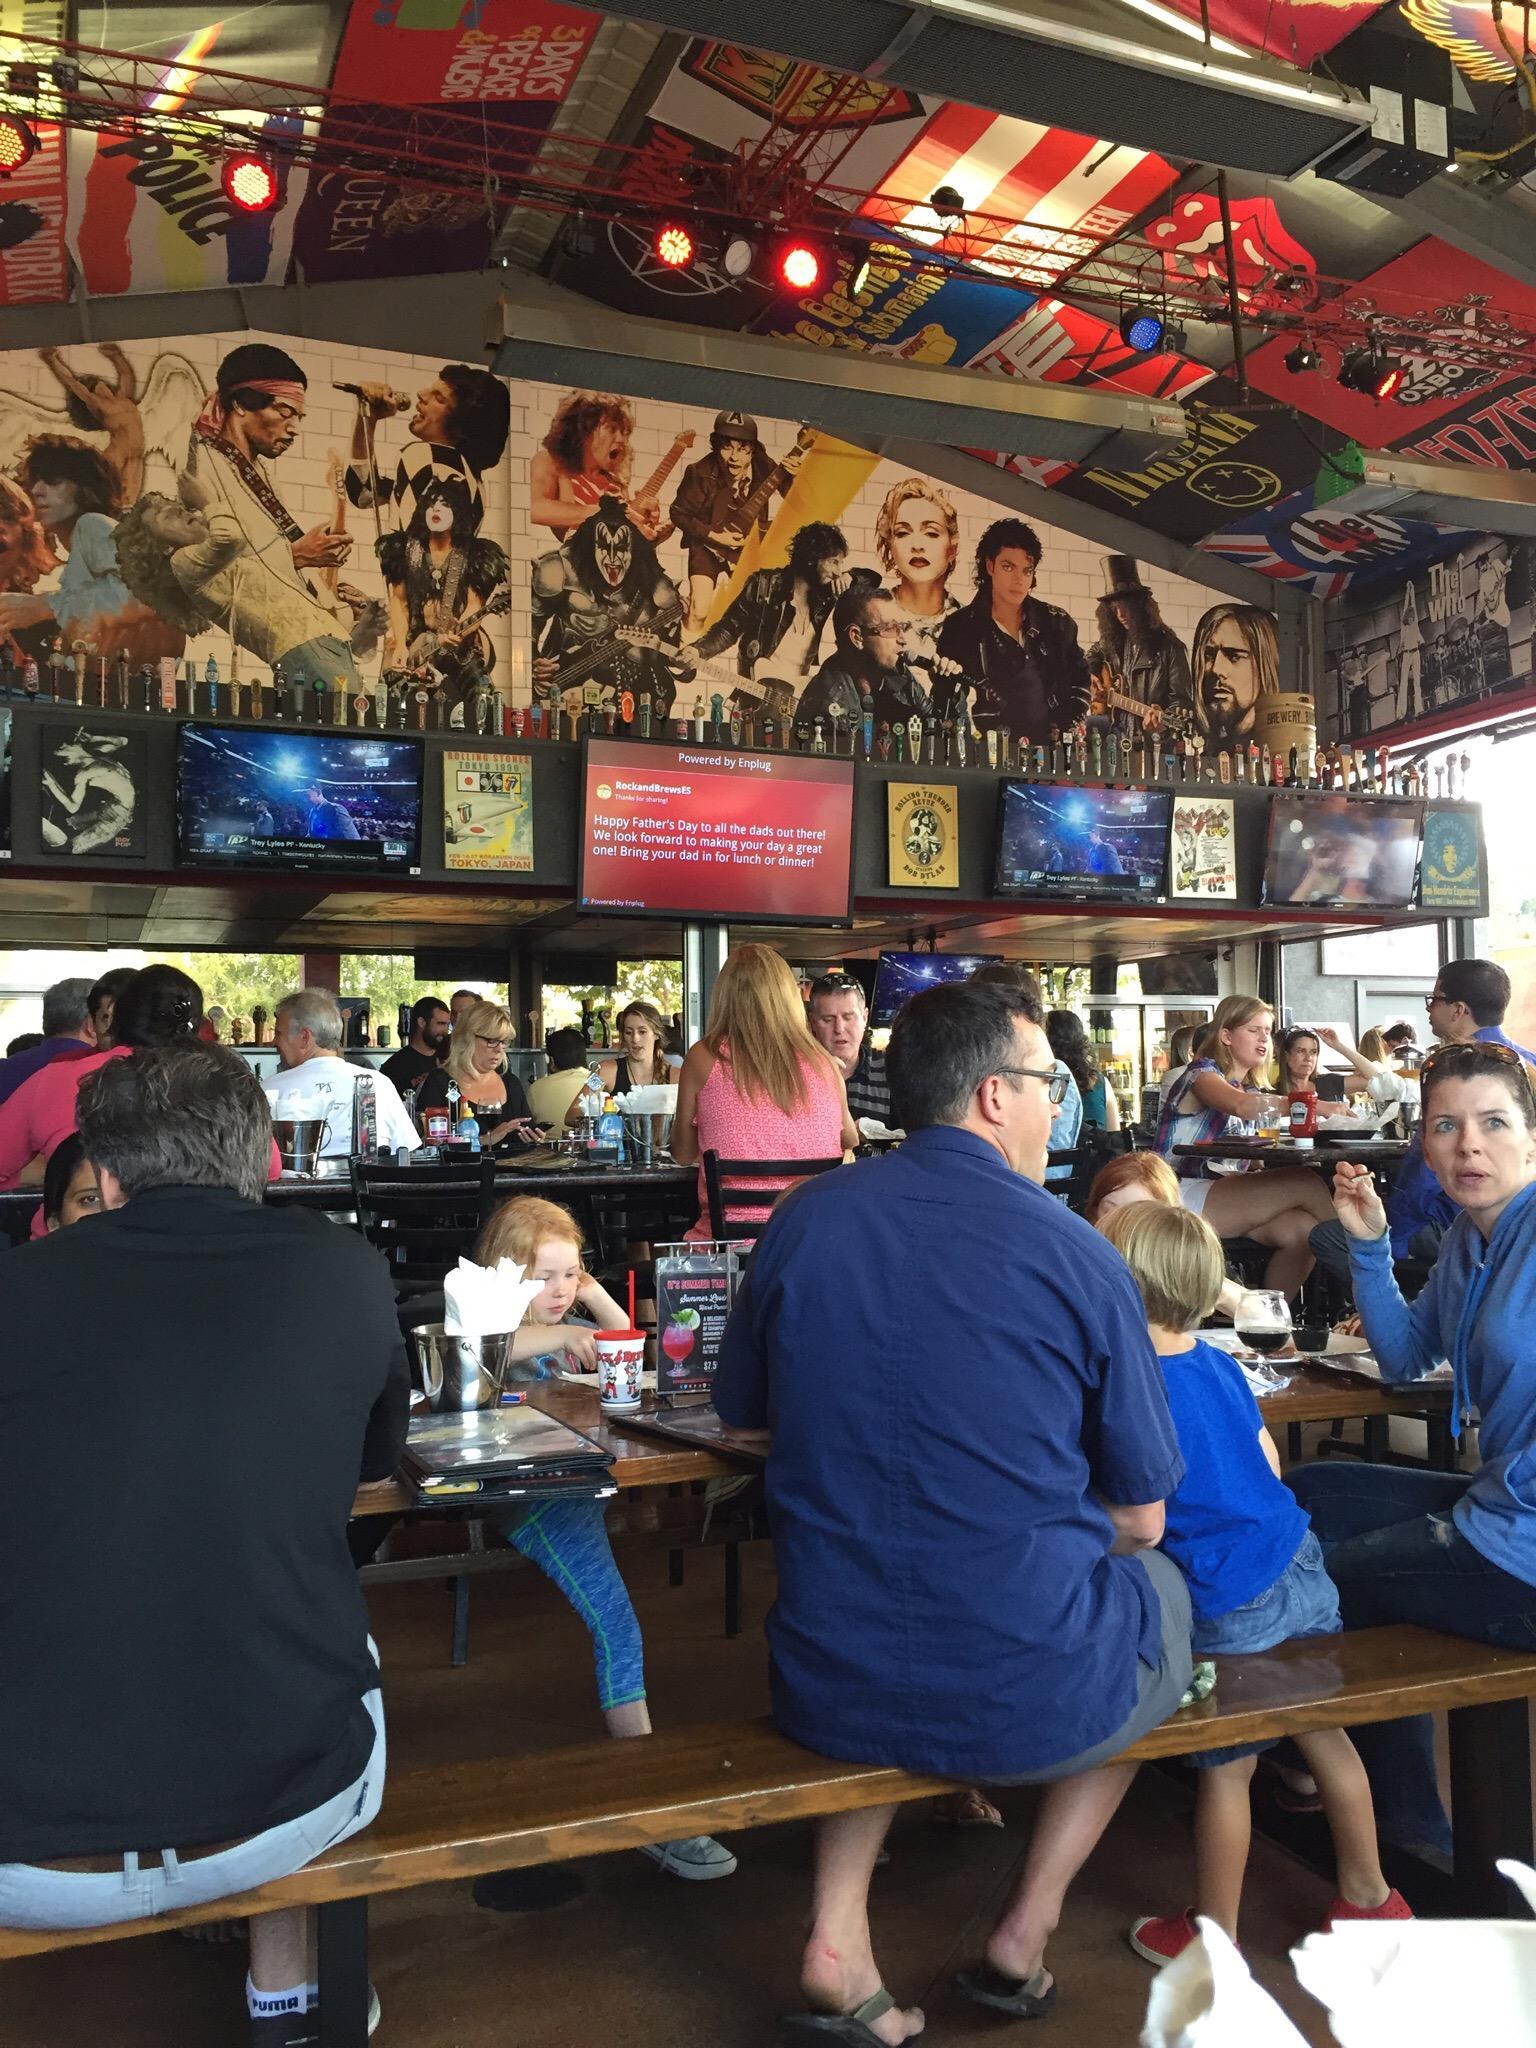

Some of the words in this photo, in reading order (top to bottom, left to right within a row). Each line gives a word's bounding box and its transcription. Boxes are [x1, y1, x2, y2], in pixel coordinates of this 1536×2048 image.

[440, 44, 494, 98] MUSIC
[478, 40, 538, 99] PEACE
[523, 41, 584, 95] DAYS
[1267, 710, 1301, 725] BREWERY
[448, 752, 488, 761] ROLLING
[493, 754, 529, 763] STONES
[678, 753, 721, 766] Powered
[724, 756, 737, 769] by
[738, 758, 772, 772] Enplug
[459, 761, 490, 770] TOKYO
[615, 781, 692, 795] RockandBrewsES
[615, 793, 635, 801] Thanks
[895, 791, 920, 813] ROLLING
[923, 791, 952, 814] THUNDER
[594, 814, 630, 830] Happy
[632, 816, 675, 830] Father's
[677, 820, 698, 834] Day
[700, 822, 712, 833] to
[714, 823, 727, 833] all
[729, 823, 747, 835] the
[749, 825, 774, 837] dads
[776, 828, 794, 838] out
[796, 829, 826, 840] there!
[299, 842, 326, 850] Kentucky
[593, 829, 611, 840] We
[614, 831, 638, 843] look
[640, 832, 683, 846] forward
[685, 836, 697, 846] to
[699, 837, 738, 851] making
[740, 840, 764, 852] your
[767, 841, 785, 853] day
[787, 843, 794, 852] a
[796, 844, 822, 855] great
[449, 859, 492, 869] TOKYO,
[495, 860, 531, 869] JAPAN
[592, 846, 617, 857] one!
[620, 846, 649, 860] Bring
[651, 850, 677, 861] your
[679, 849, 699, 861] dad
[702, 850, 712, 861] in
[715, 851, 730, 863] for
[733, 851, 761, 864] lunch
[764, 856, 776, 865] or
[778, 855, 815, 868] dinner!
[903, 864, 918, 878] BOB
[920, 864, 946, 879] DYLAN
[590, 898, 616, 906] Powered
[681, 1279, 710, 1289] SUMMER
[680, 1293, 708, 1304] Summer
[252, 1996, 299, 2012] PUMA
